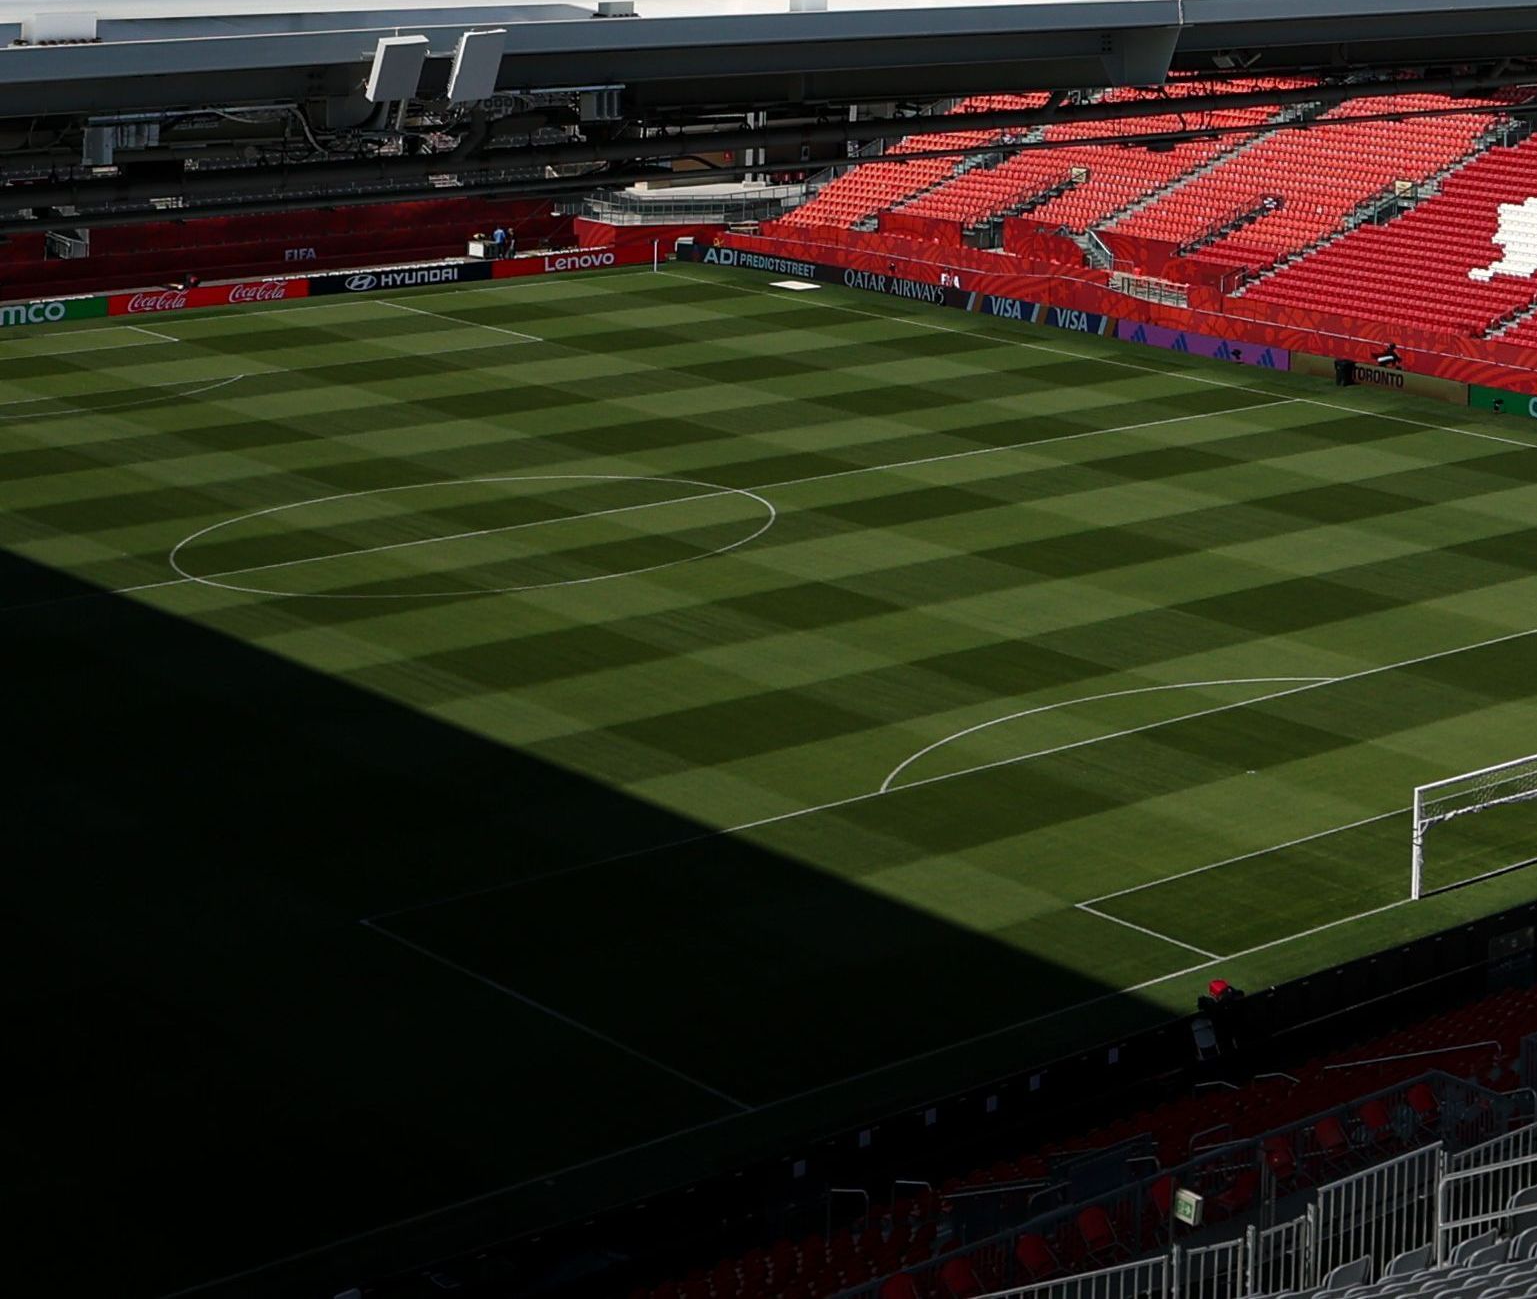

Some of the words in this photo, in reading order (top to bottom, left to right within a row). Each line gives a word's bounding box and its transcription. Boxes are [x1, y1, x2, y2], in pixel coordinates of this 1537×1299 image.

[285, 247, 316, 262] FIFA
[544, 251, 614, 272] Lenovo
[703, 248, 738, 267] ADI
[740, 254, 816, 278] PREDICTSTREET
[381, 268, 458, 287] HYUNDAI
[843, 268, 886, 293] QATAR
[890, 277, 945, 304] AIRWAYS
[990, 295, 1022, 320] VISA
[1055, 307, 1088, 332] VISA
[1353, 366, 1404, 389] TORONTO
